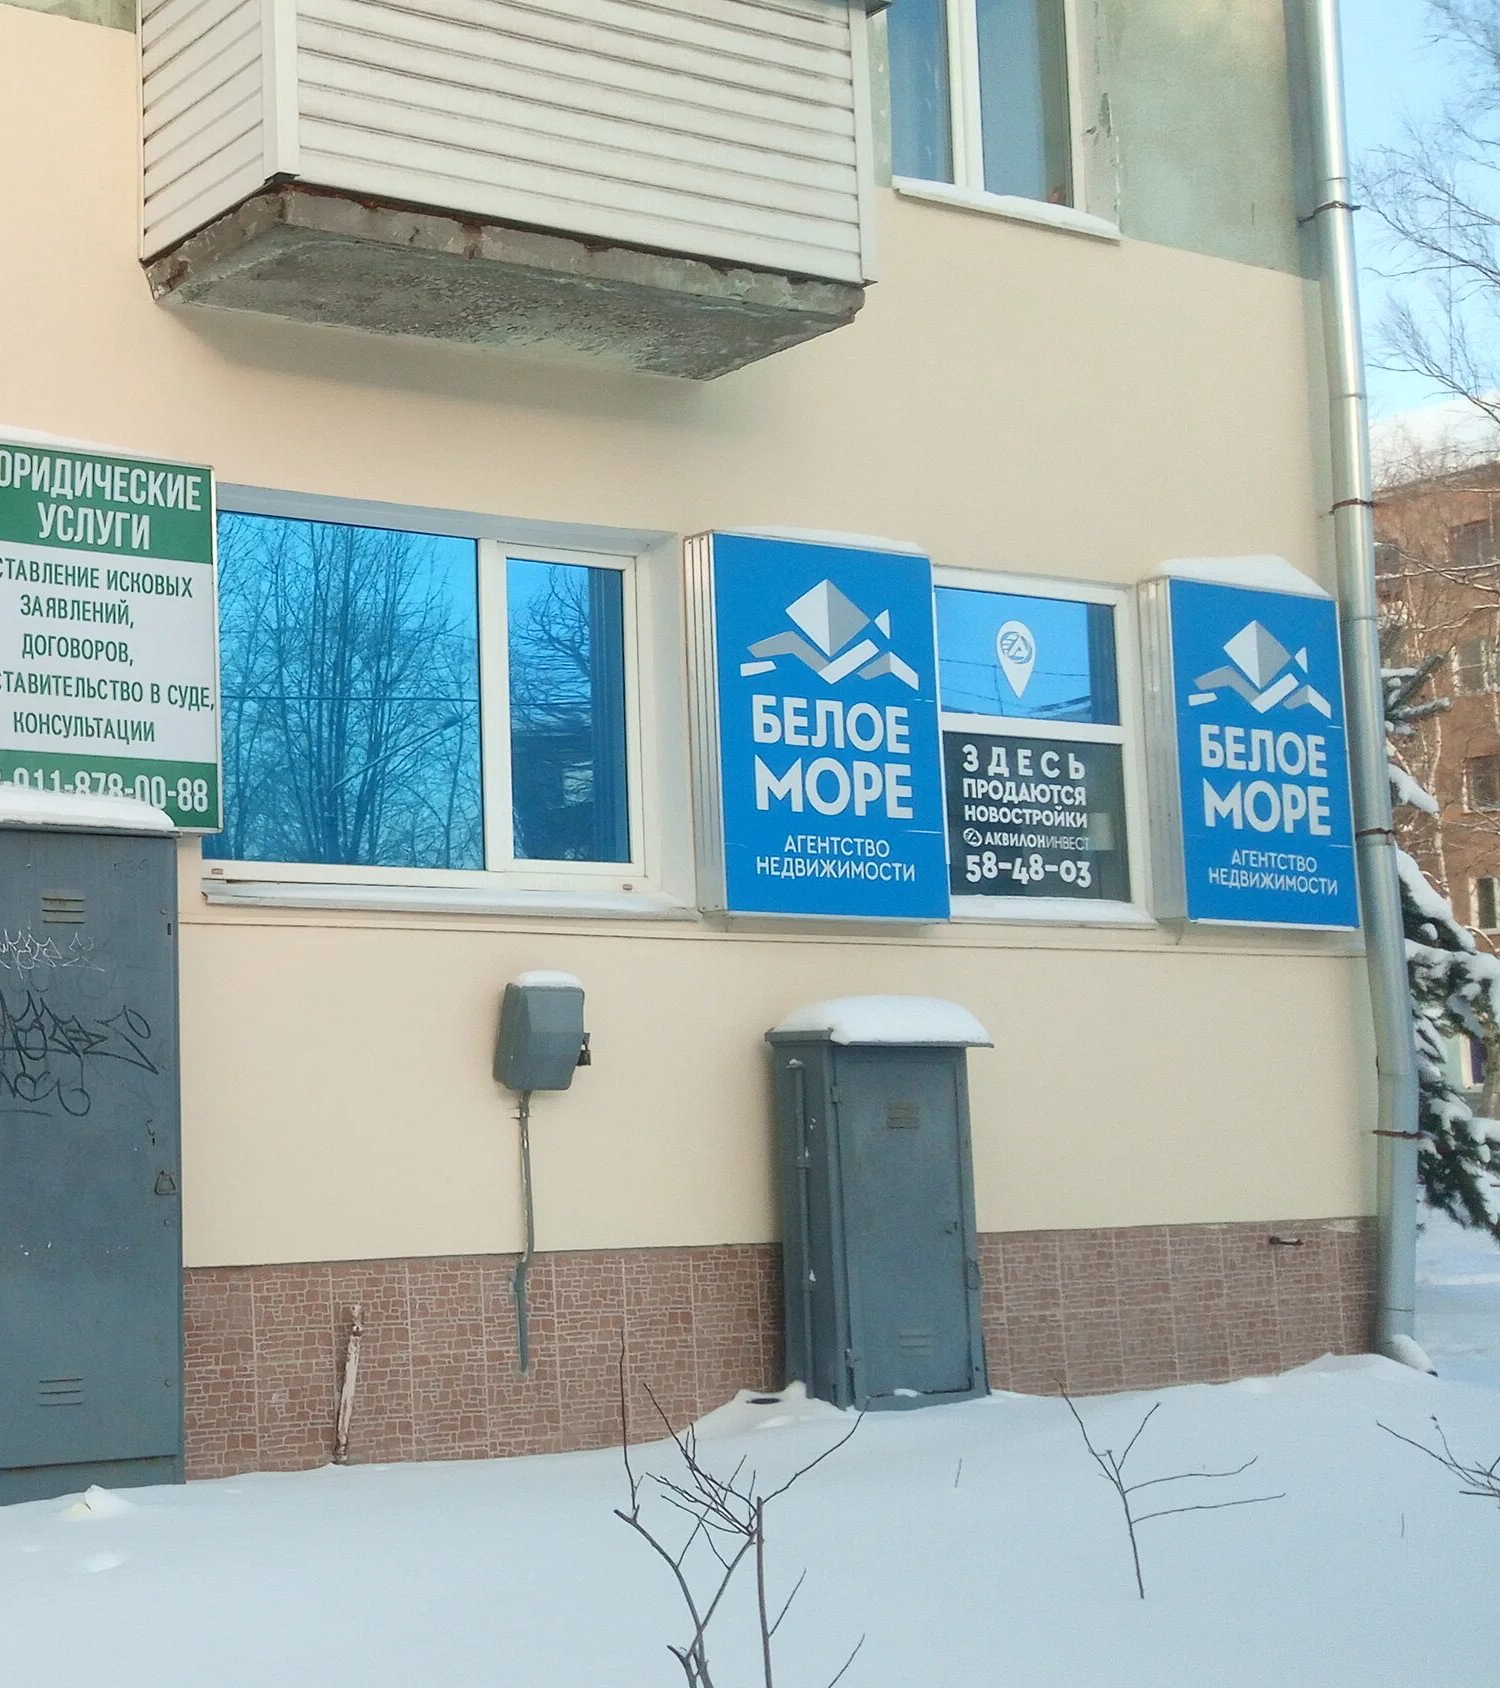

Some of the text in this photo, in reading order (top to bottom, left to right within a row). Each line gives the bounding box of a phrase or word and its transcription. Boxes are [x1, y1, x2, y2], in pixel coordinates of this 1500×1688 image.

[38, 502, 149, 550] УСЛУГИ
[107, 570, 192, 598] ИСКОВЫХ
[20, 595, 133, 629] ЗАЯВЛЕНИЙ,
[22, 634, 133, 666] ДОГОВОРОВ,
[150, 682, 161, 704] В
[167, 684, 214, 712] СУДЕ,
[14, 712, 154, 745] КОНСУЛЬТАЦИИ
[753, 695, 910, 753] БЕЛОЕ
[963, 744, 1085, 779] ЗДЕСЬ
[1200, 724, 1327, 777] БЕЛОЕ
[755, 755, 913, 818] МОРЕ
[963, 778, 1086, 805] ПРОДАЮТСЯ
[965, 805, 1087, 828] НОВОСТРОЙКИ
[1203, 778, 1331, 835] МОРЕ
[785, 835, 889, 857] АГЕНТСТВО
[1232, 849, 1317, 873] АГЕНТСТВО
[757, 857, 915, 881] НЕДВИЖИМОСТИ
[966, 851, 1091, 887] 58-48-03
[1209, 868, 1337, 895] НЕДВИЖИМОСТИ
